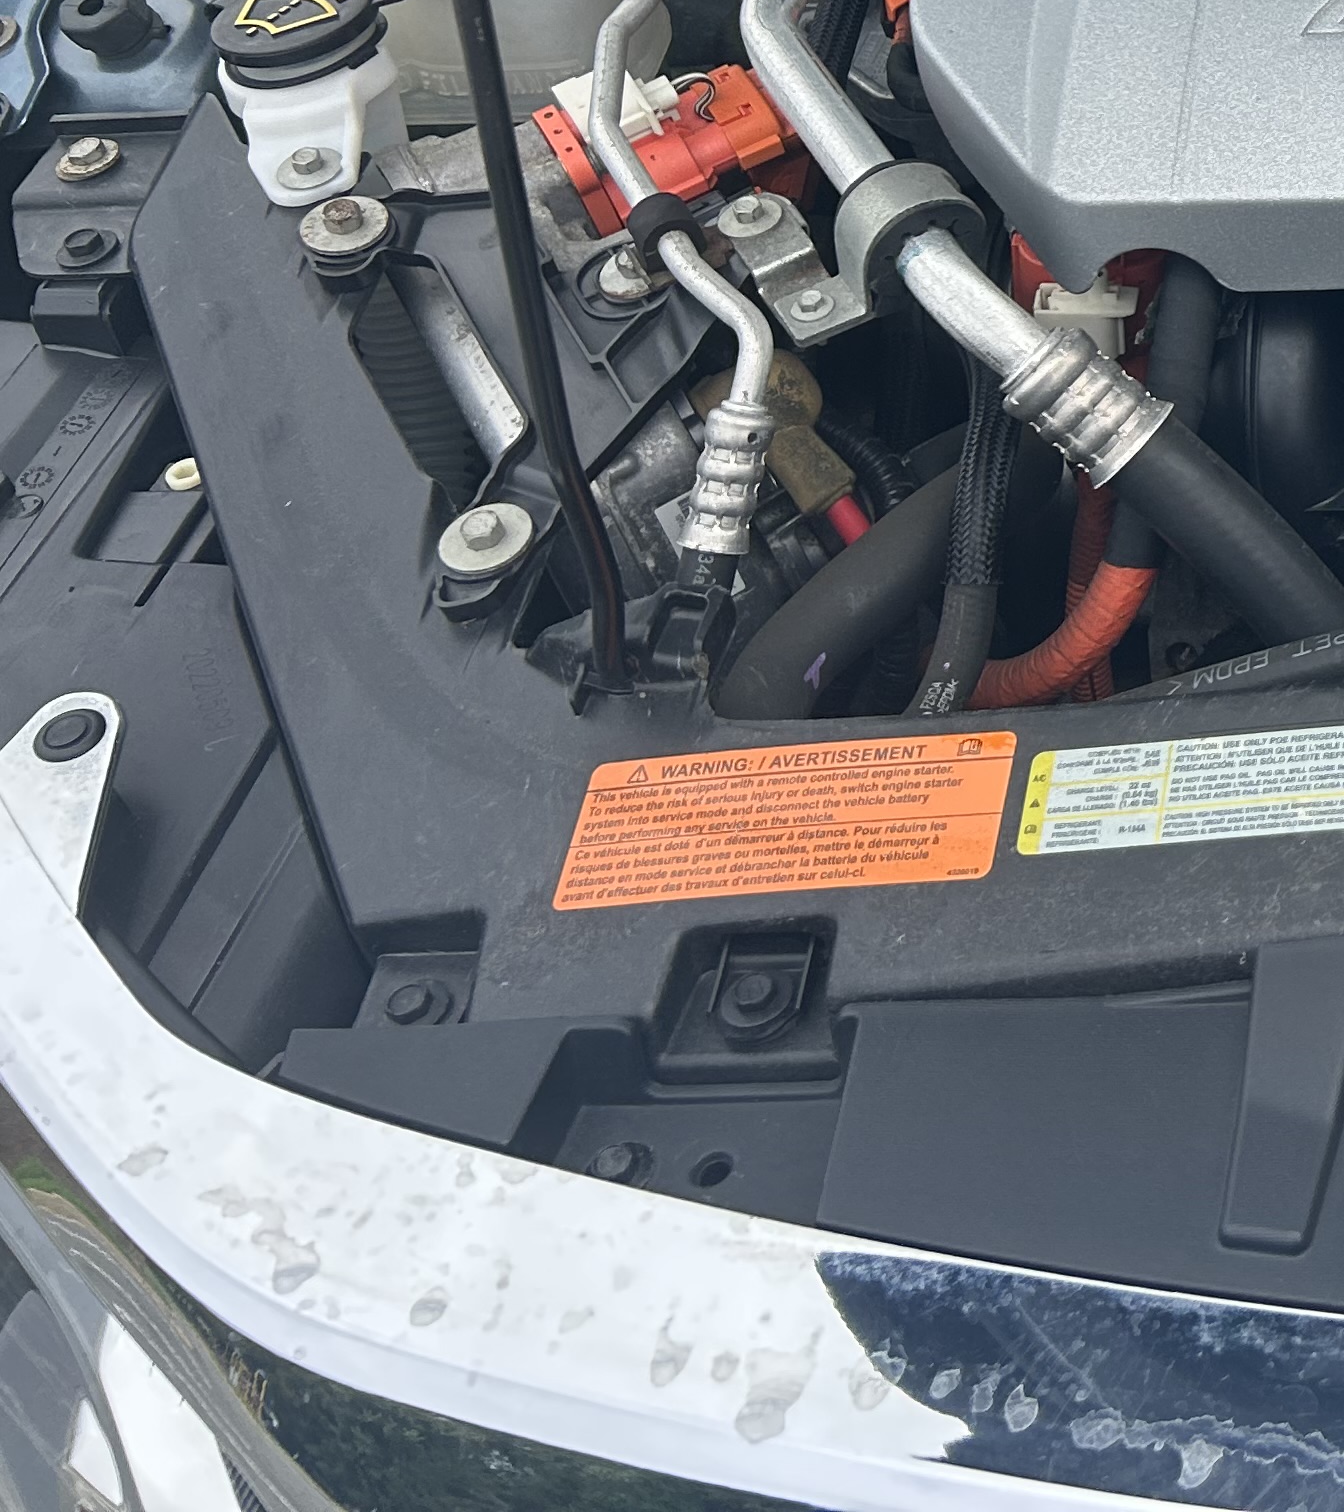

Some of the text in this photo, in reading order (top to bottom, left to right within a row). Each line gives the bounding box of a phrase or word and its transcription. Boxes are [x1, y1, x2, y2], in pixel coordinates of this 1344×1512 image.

[661, 744, 928, 779] WARNING: / AVERTISSEMENT
[592, 764, 954, 802] This vehicle is equipped with a remote controlled engine starter.
